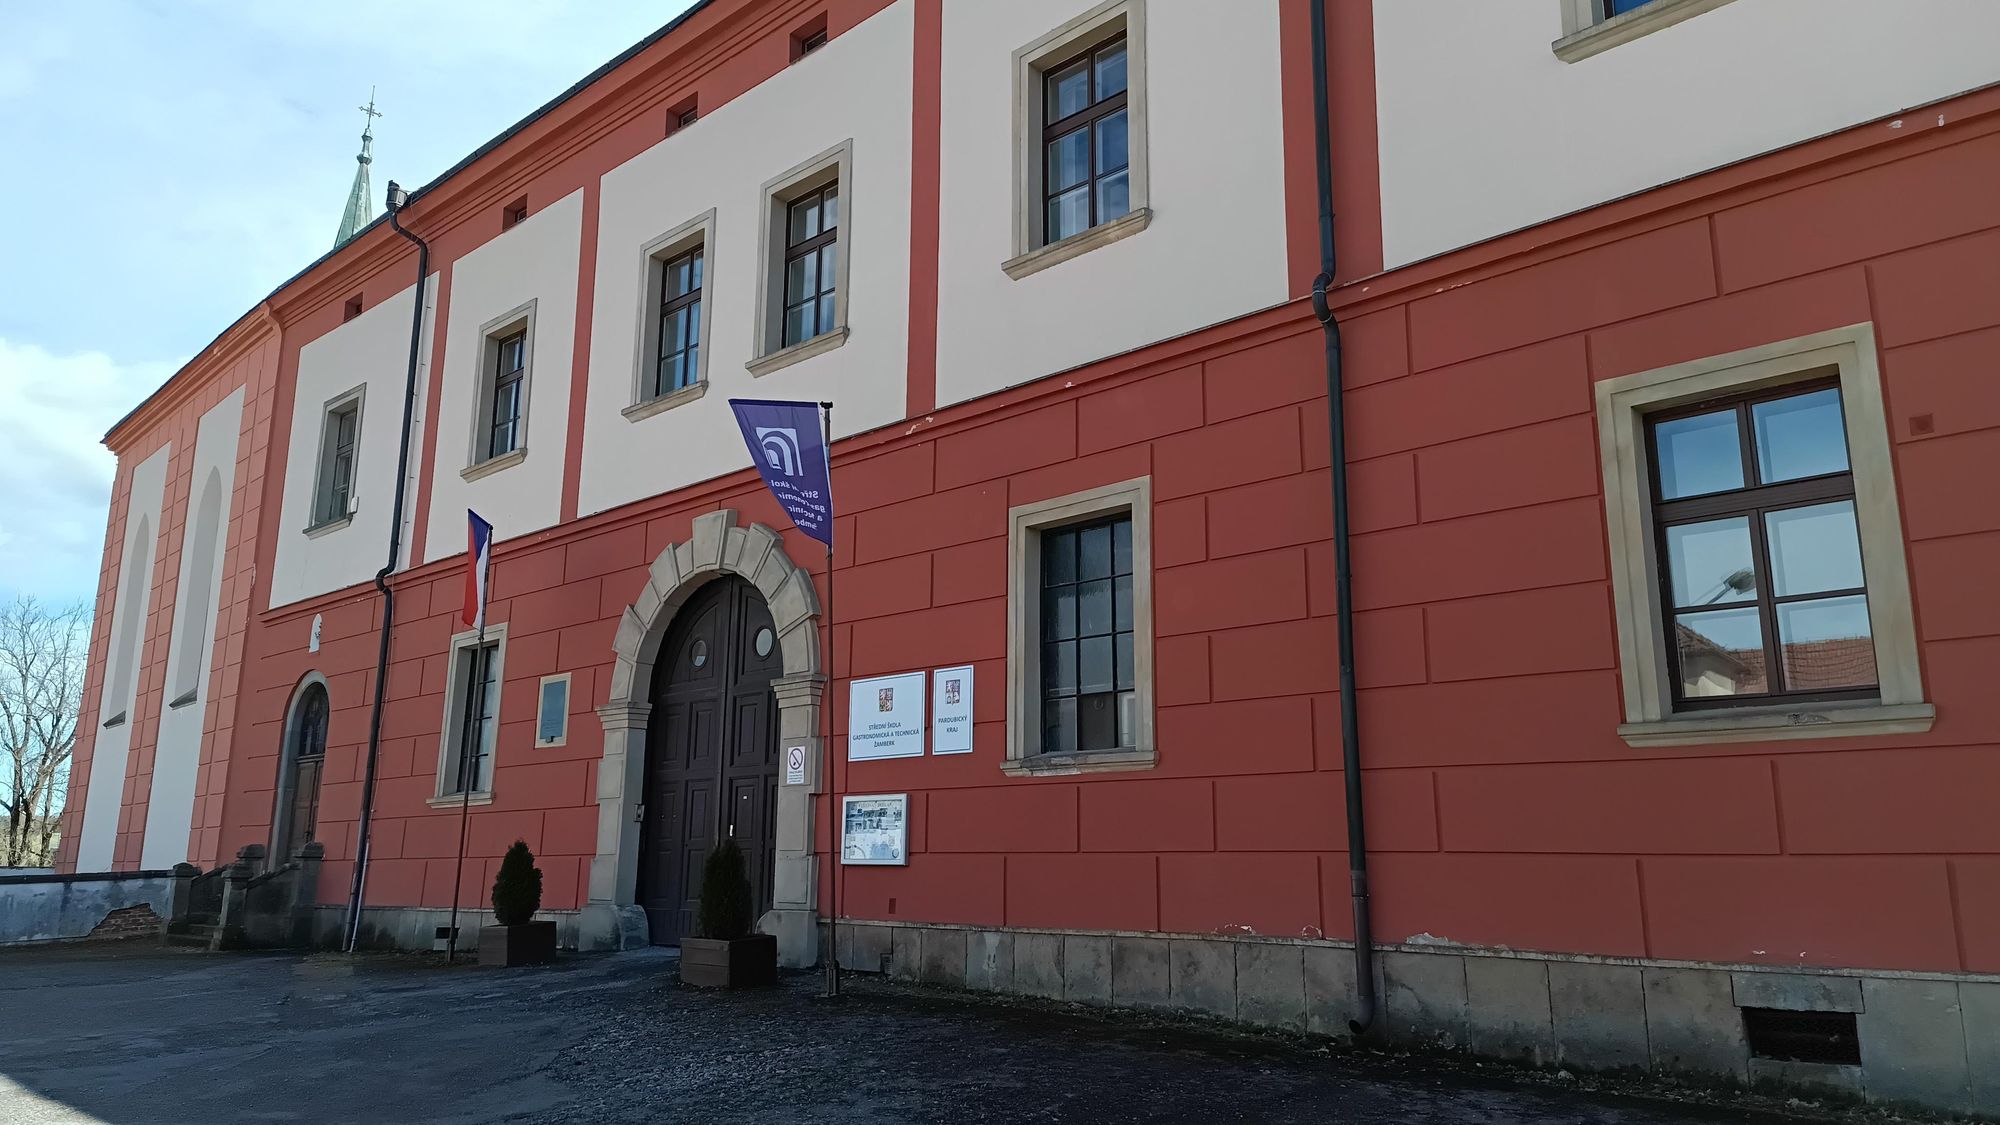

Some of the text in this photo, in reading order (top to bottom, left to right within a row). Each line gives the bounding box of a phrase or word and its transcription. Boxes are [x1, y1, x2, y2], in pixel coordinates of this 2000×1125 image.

[938, 715, 967, 723] PARDUBICKÝ
[868, 721, 901, 730] STŘEDNÍ ŠKOLA
[852, 731, 890, 740] GASTRONOMICKÁ
[894, 728, 919, 736] TECHNICKÁ
